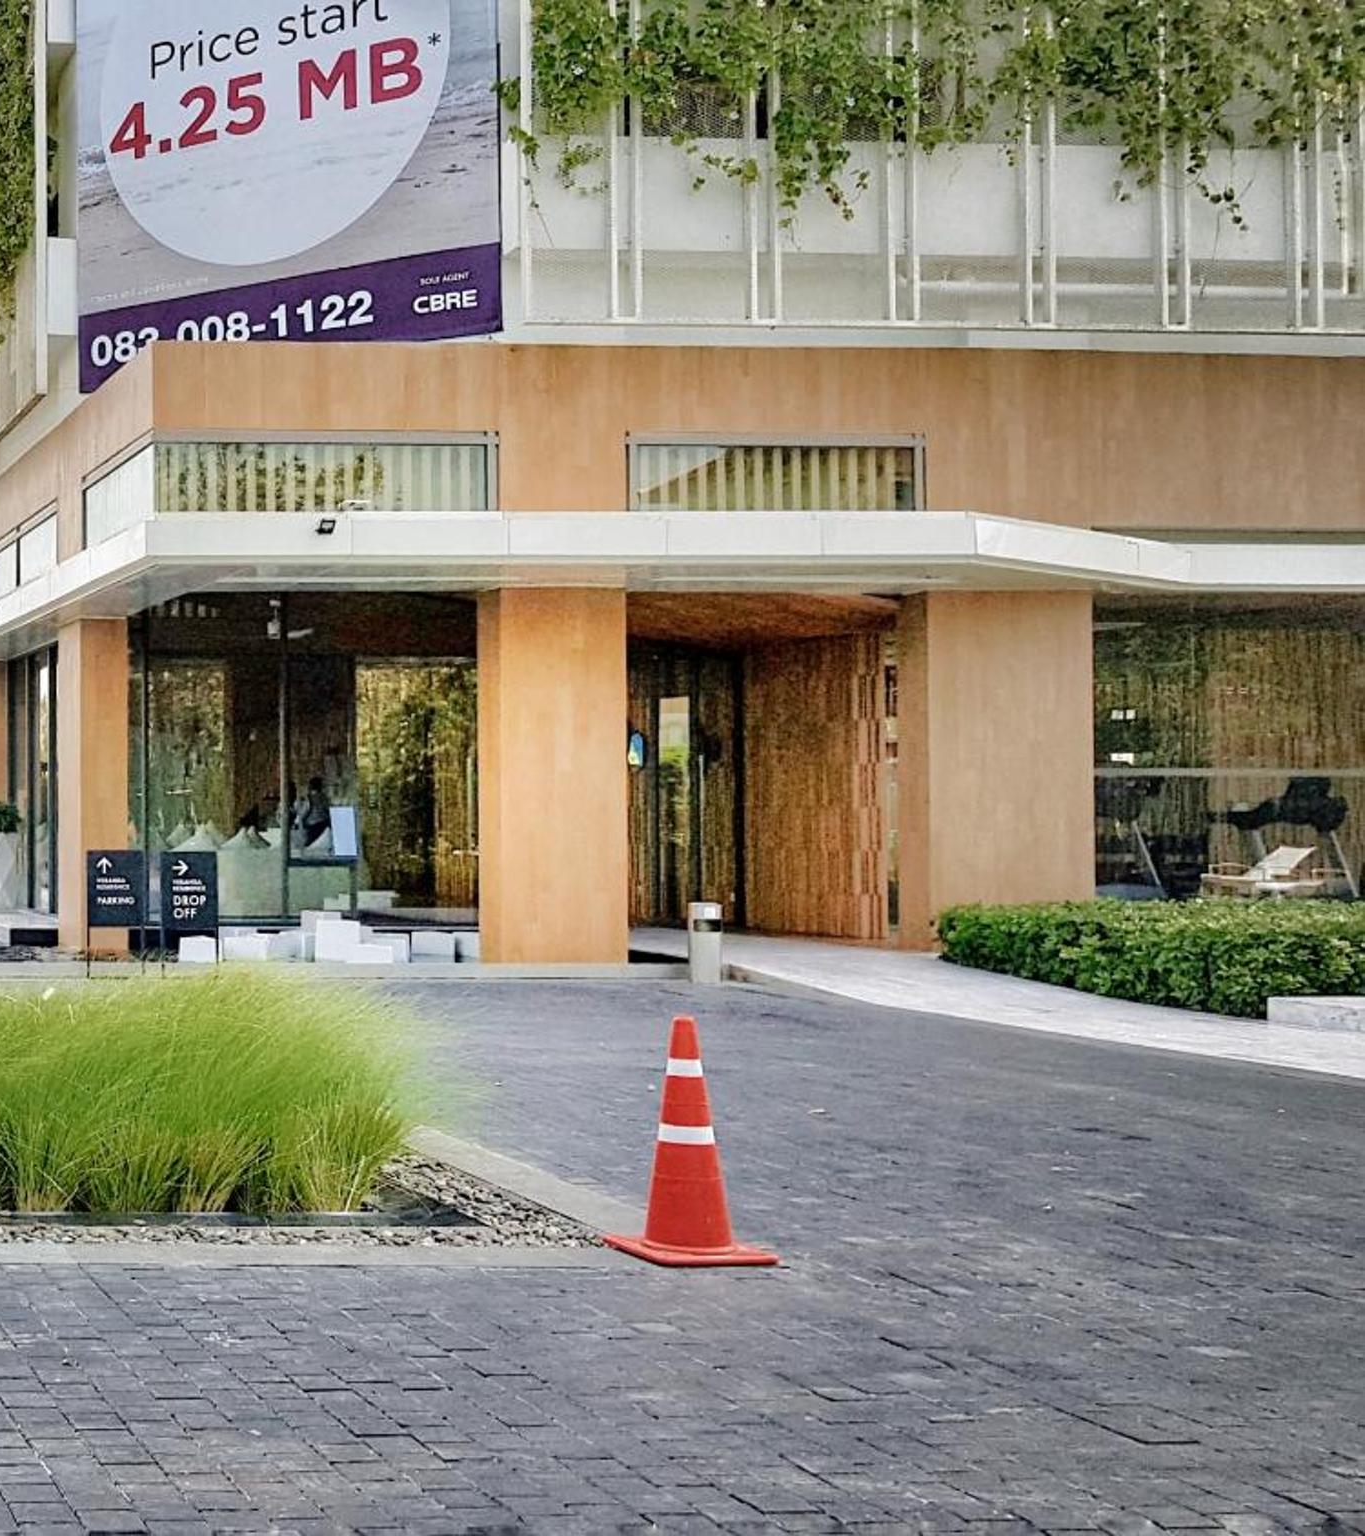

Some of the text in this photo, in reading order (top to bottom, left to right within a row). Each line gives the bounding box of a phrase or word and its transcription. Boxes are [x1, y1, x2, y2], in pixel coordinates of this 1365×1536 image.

[150, 0, 388, 80] Price start
[109, 72, 267, 160] 4.25
[413, 289, 478, 314] CBRE
[97, 896, 135, 905] PARKING
[173, 895, 207, 906] DROP
[173, 908, 197, 919] OFF
